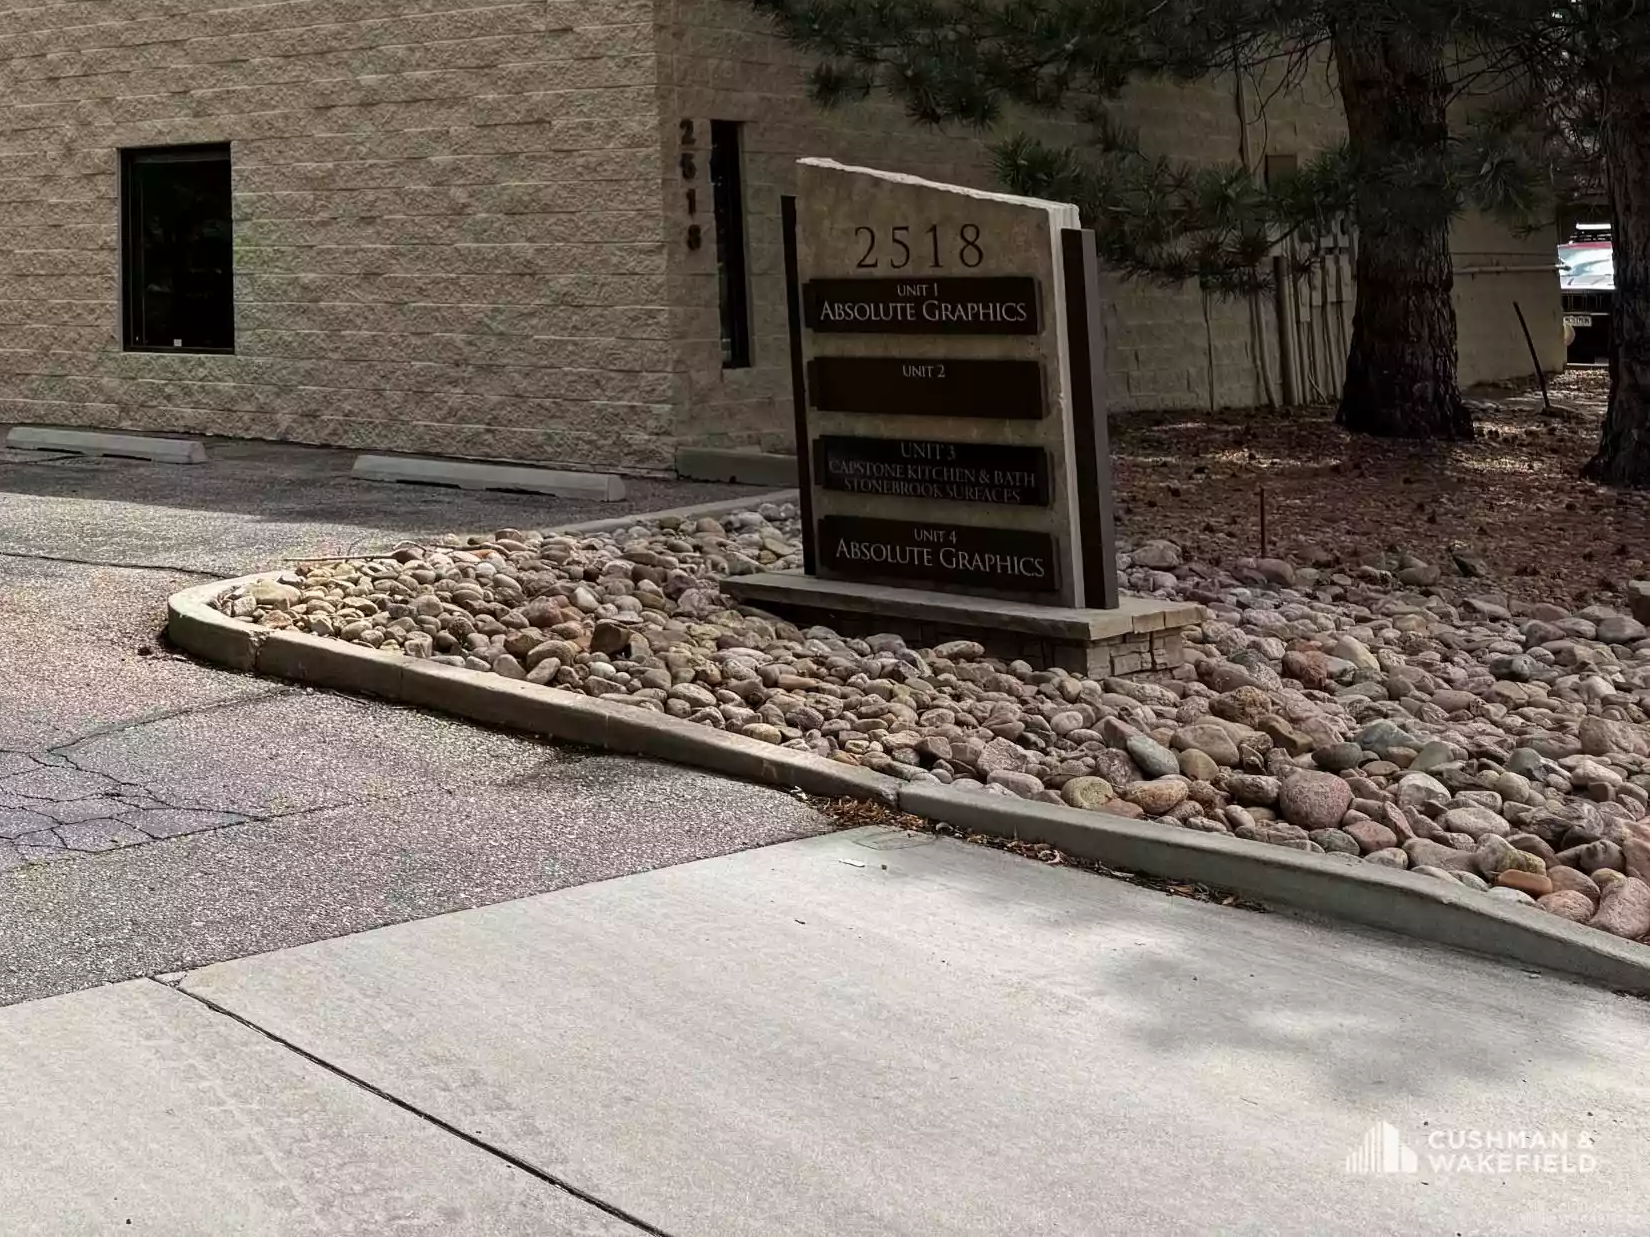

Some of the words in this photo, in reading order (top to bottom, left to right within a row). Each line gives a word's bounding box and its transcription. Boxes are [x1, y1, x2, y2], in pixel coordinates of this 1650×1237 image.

[680, 119, 701, 250] 2518
[854, 223, 983, 268] 2518
[897, 284, 929, 297] UNIT
[820, 300, 915, 322] ABSOLUTE
[922, 300, 1028, 322] GRAPHICS
[902, 364, 934, 378] UNIT
[937, 364, 946, 378] 2
[900, 442, 944, 460] UNIT
[946, 445, 956, 461] 3
[828, 460, 905, 478] CAPSTONE
[907, 464, 975, 483] KITCHEN
[979, 469, 990, 484] &
[994, 470, 1036, 488] BATH
[844, 477, 944, 498] STONEBROOK
[945, 484, 1022, 503] SURFACES
[913, 528, 945, 543] UNIT
[949, 530, 957, 544] 4
[836, 537, 933, 566] ABSOLUTE
[939, 547, 1045, 577] GRAPHICS
